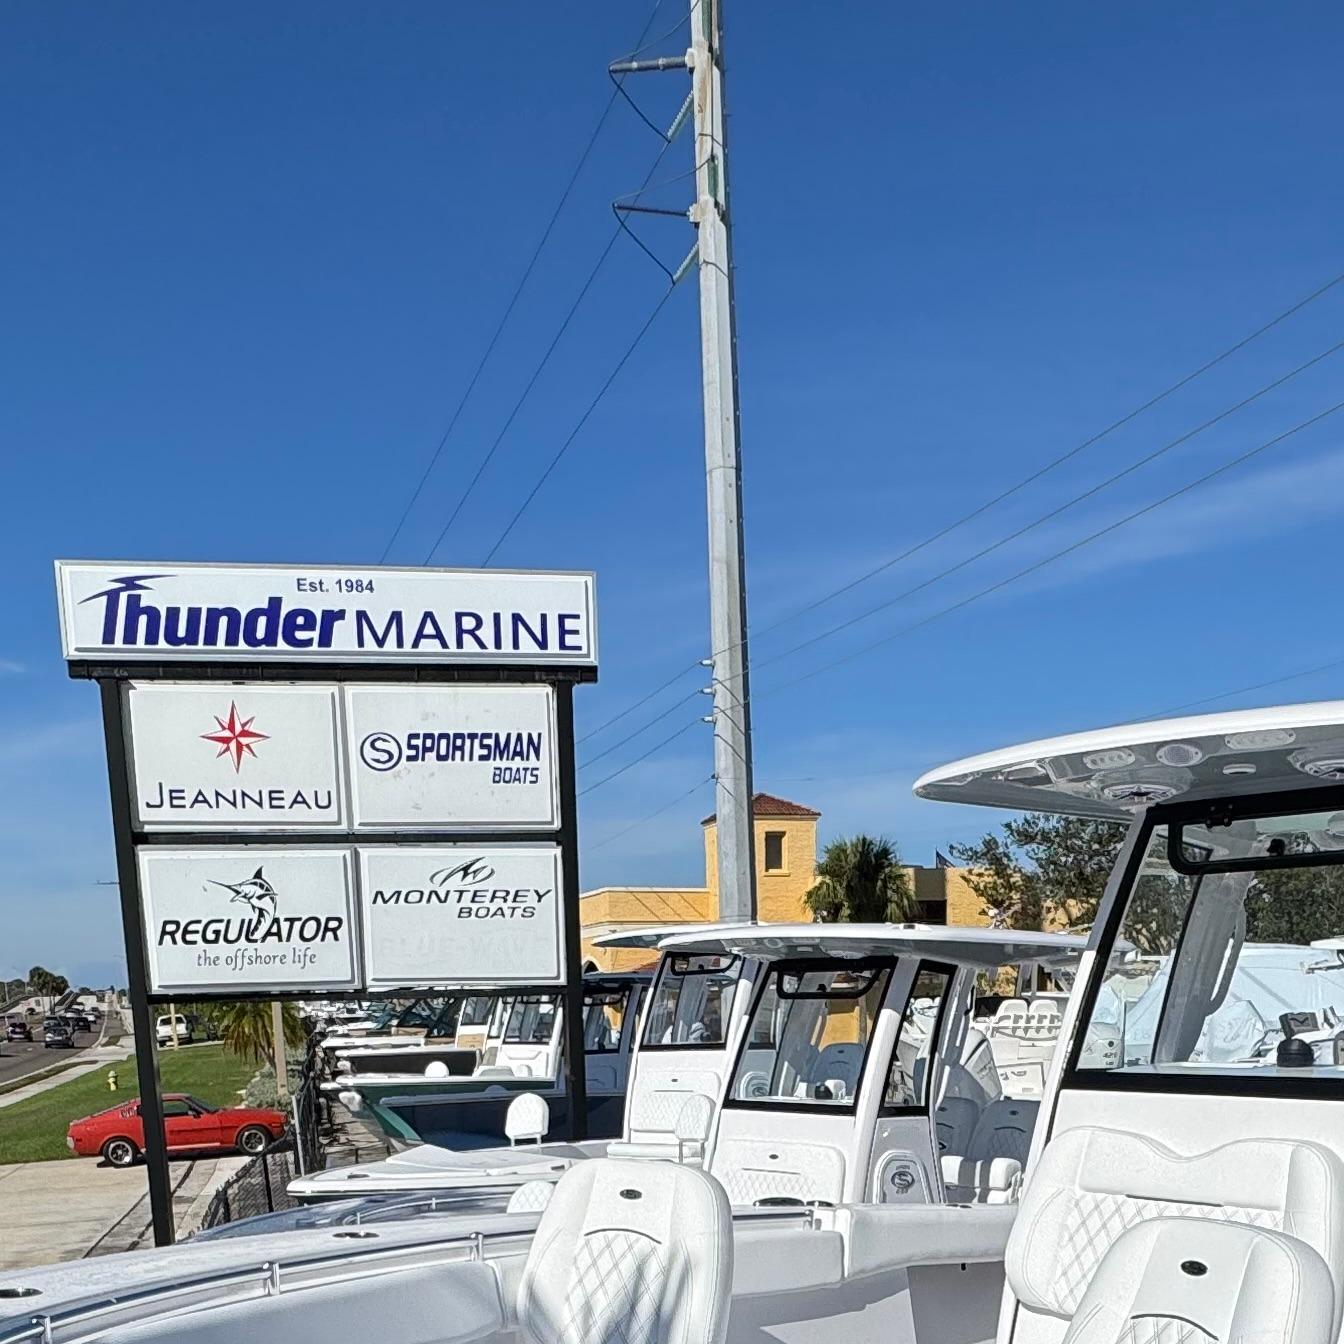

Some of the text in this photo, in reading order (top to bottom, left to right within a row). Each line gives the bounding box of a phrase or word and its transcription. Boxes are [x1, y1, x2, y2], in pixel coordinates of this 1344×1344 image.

[296, 578, 375, 593] Est. 1984
[77, 575, 582, 651] Thunder MARINE
[405, 732, 543, 762] SPORTSMAN
[492, 767, 540, 784] BOATS
[145, 782, 333, 810] JEANNEAU
[371, 889, 553, 905] MONTEREY
[457, 906, 537, 919] BOATS
[158, 916, 343, 946] REGULATOR
[197, 947, 316, 971] the offshore life
